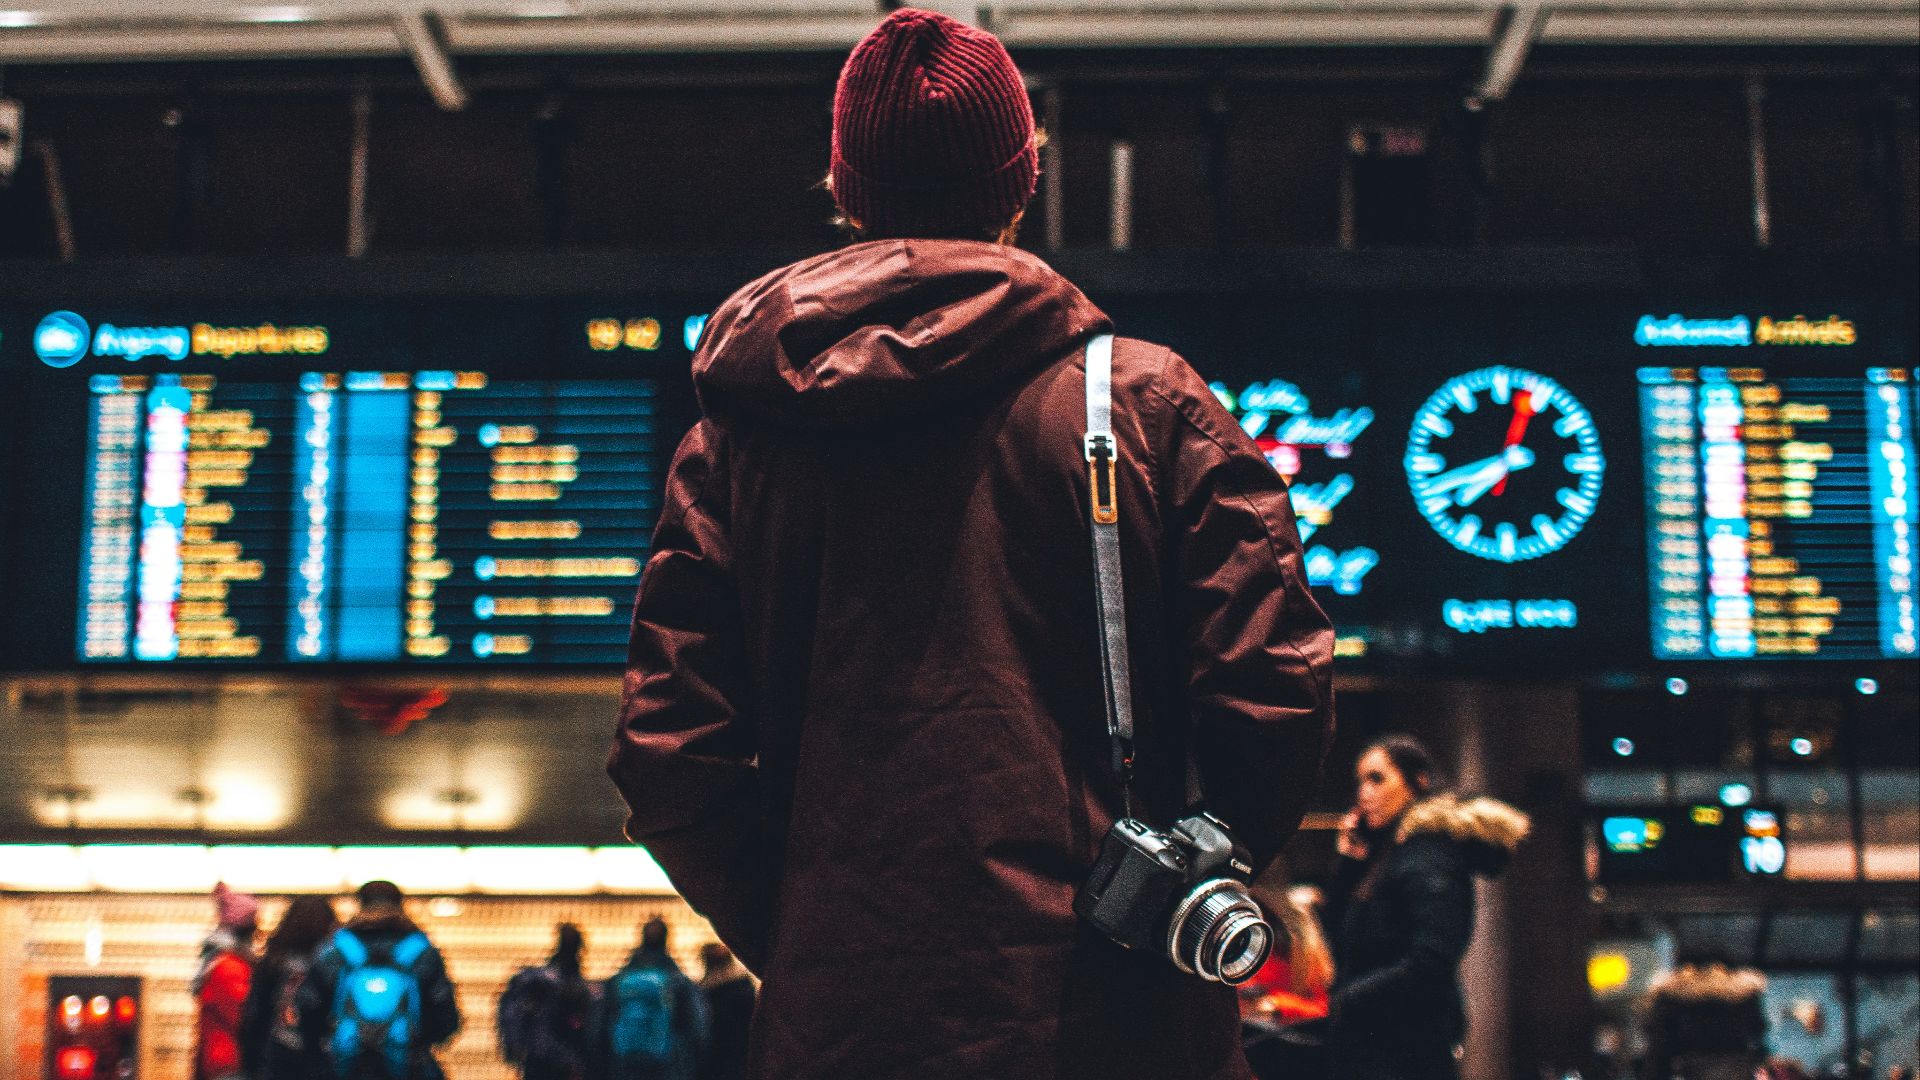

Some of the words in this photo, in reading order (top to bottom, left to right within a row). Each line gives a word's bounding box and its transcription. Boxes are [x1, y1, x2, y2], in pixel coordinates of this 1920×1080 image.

[192, 324, 328, 358] Departures
[1756, 315, 1856, 345] Arrivals
[1230, 858, 1252, 875] Canon
